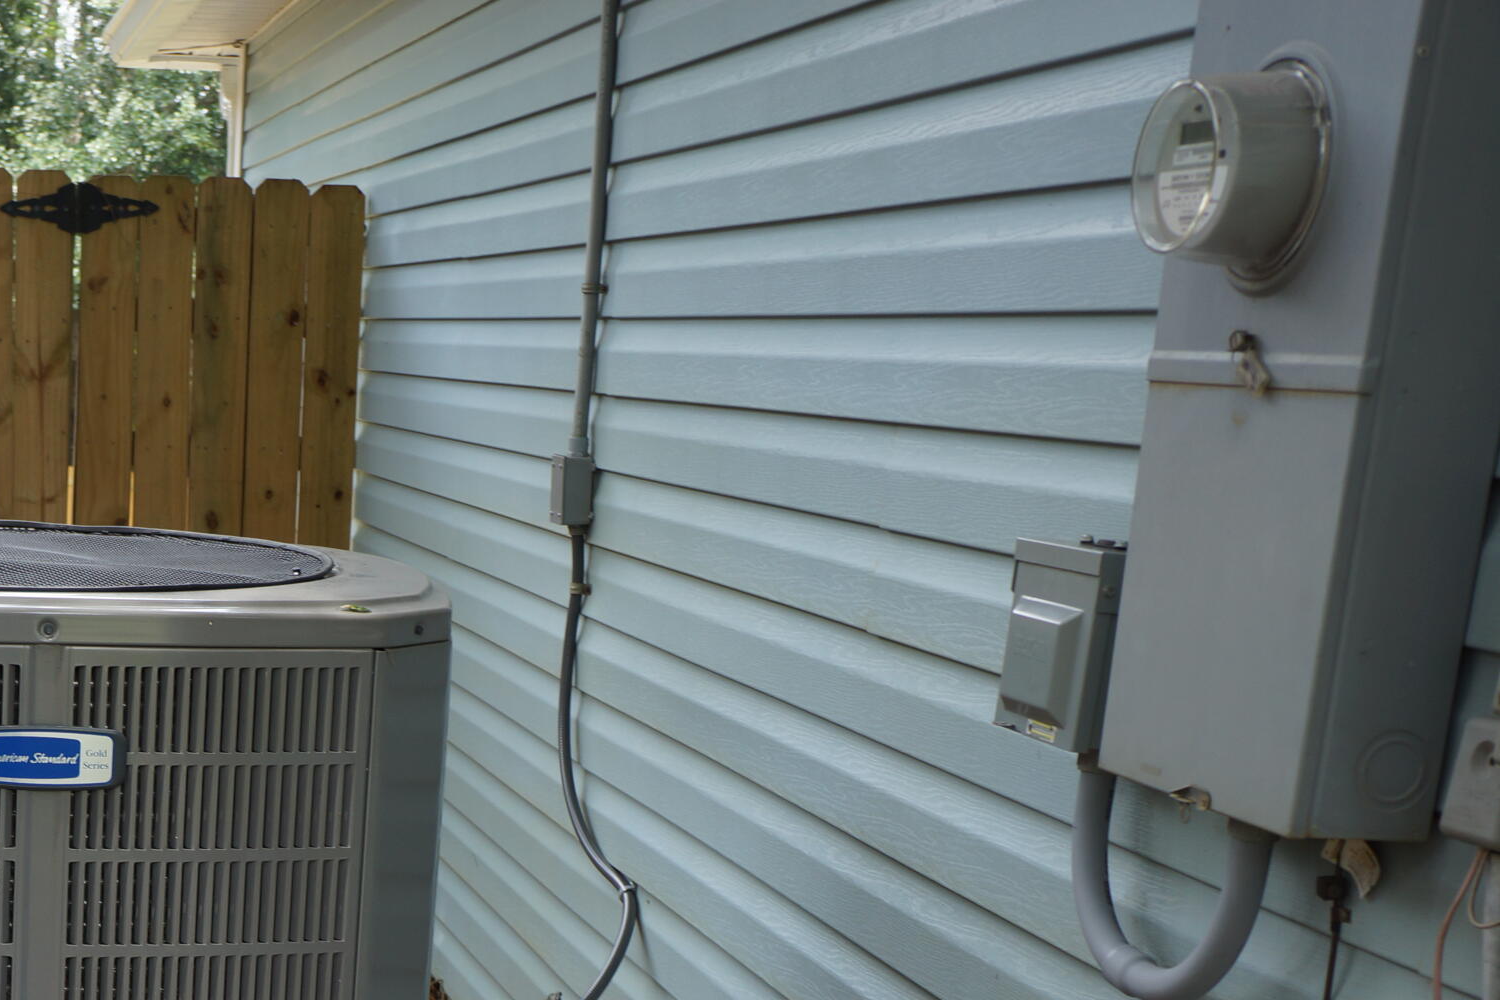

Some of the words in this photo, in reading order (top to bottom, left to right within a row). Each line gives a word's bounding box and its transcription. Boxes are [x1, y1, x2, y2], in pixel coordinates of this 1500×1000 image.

[30, 752, 78, 764] Standard
[85, 748, 108, 758] Gold
[83, 762, 109, 770] Series
